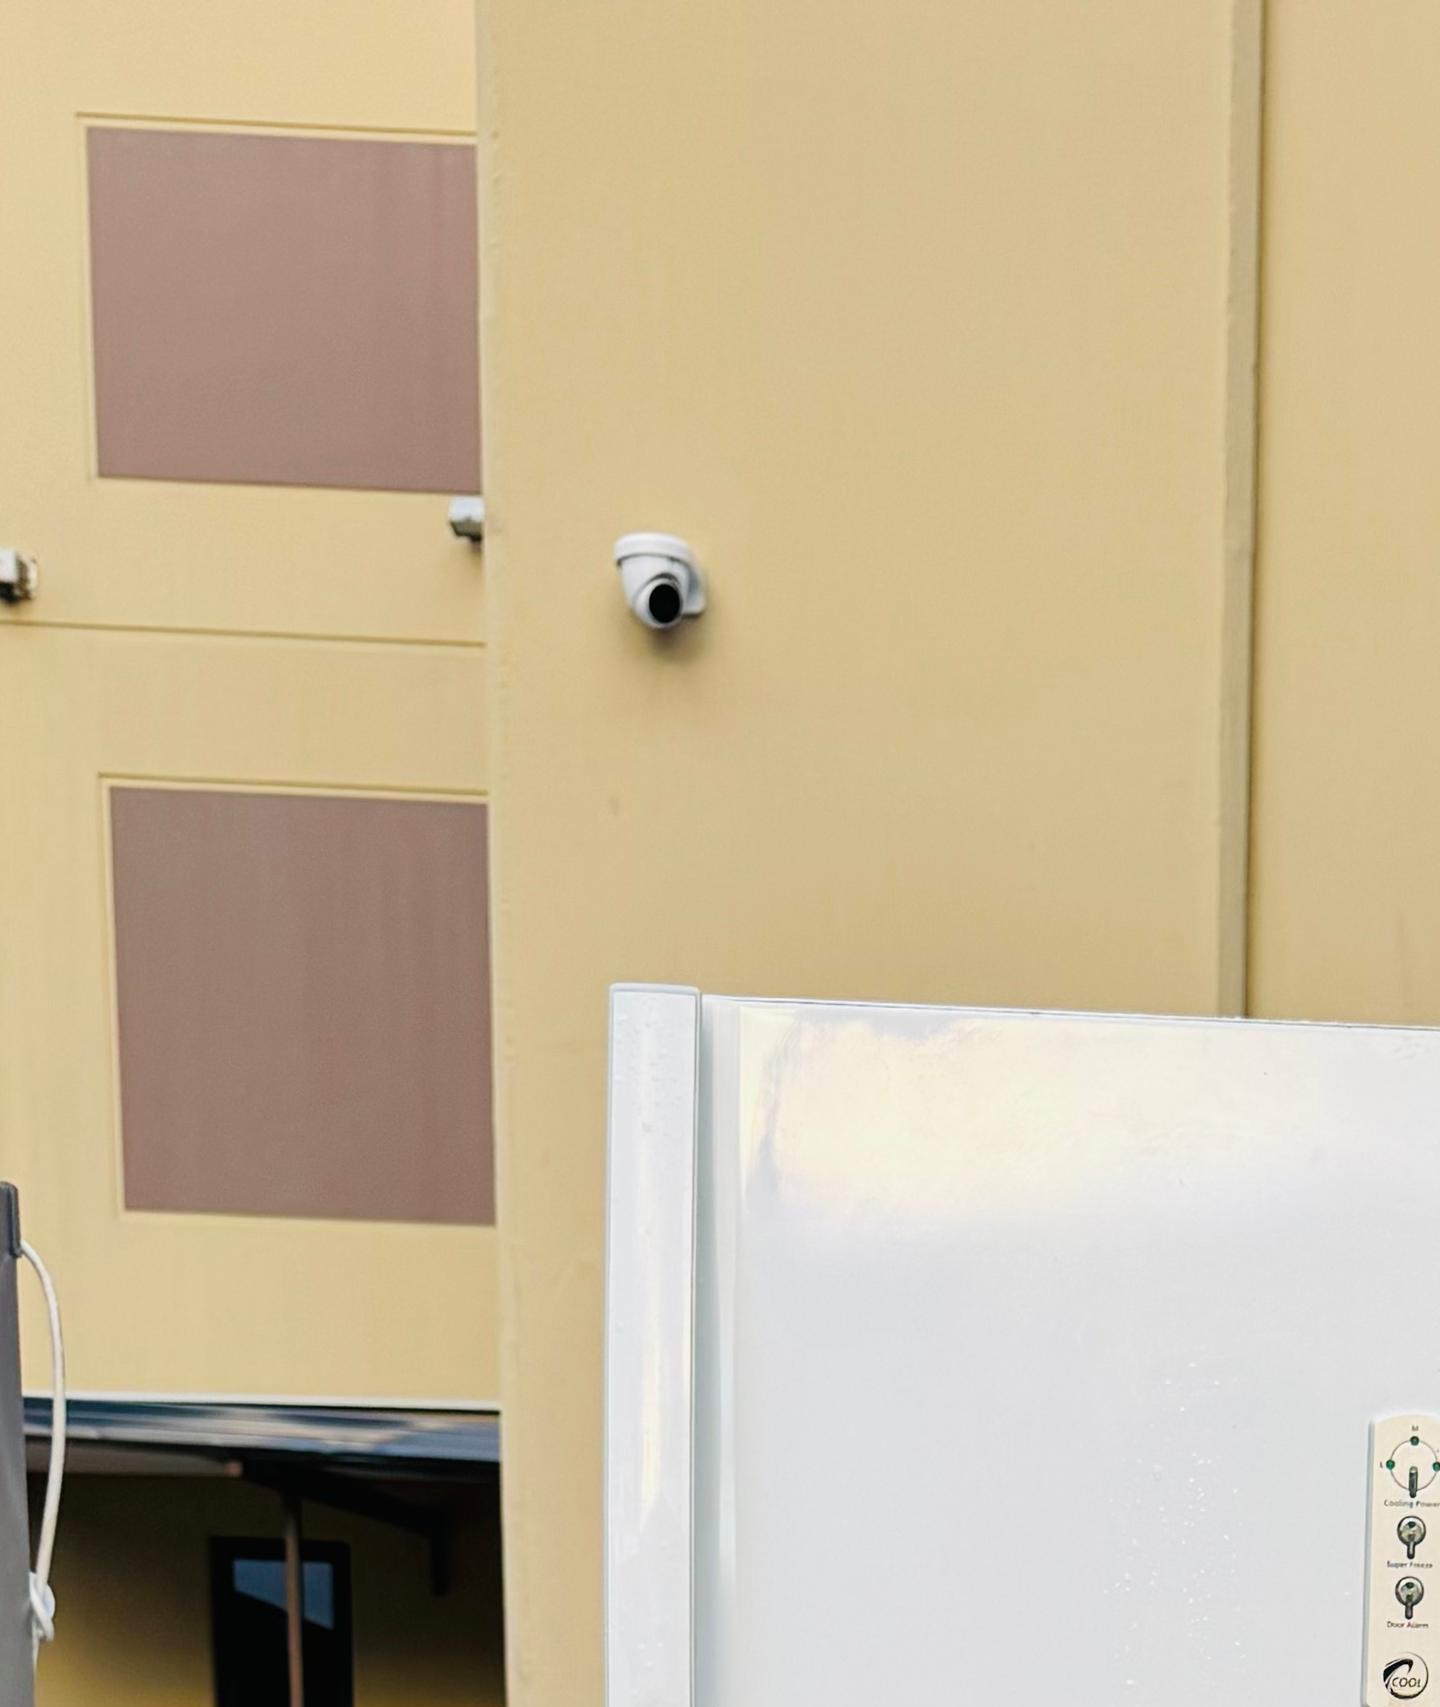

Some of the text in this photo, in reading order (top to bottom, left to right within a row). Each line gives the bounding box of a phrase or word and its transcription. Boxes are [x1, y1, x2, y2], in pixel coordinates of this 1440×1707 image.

[1383, 1499, 1440, 1509] Cooling Power
[1386, 1620, 1405, 1628] Door
